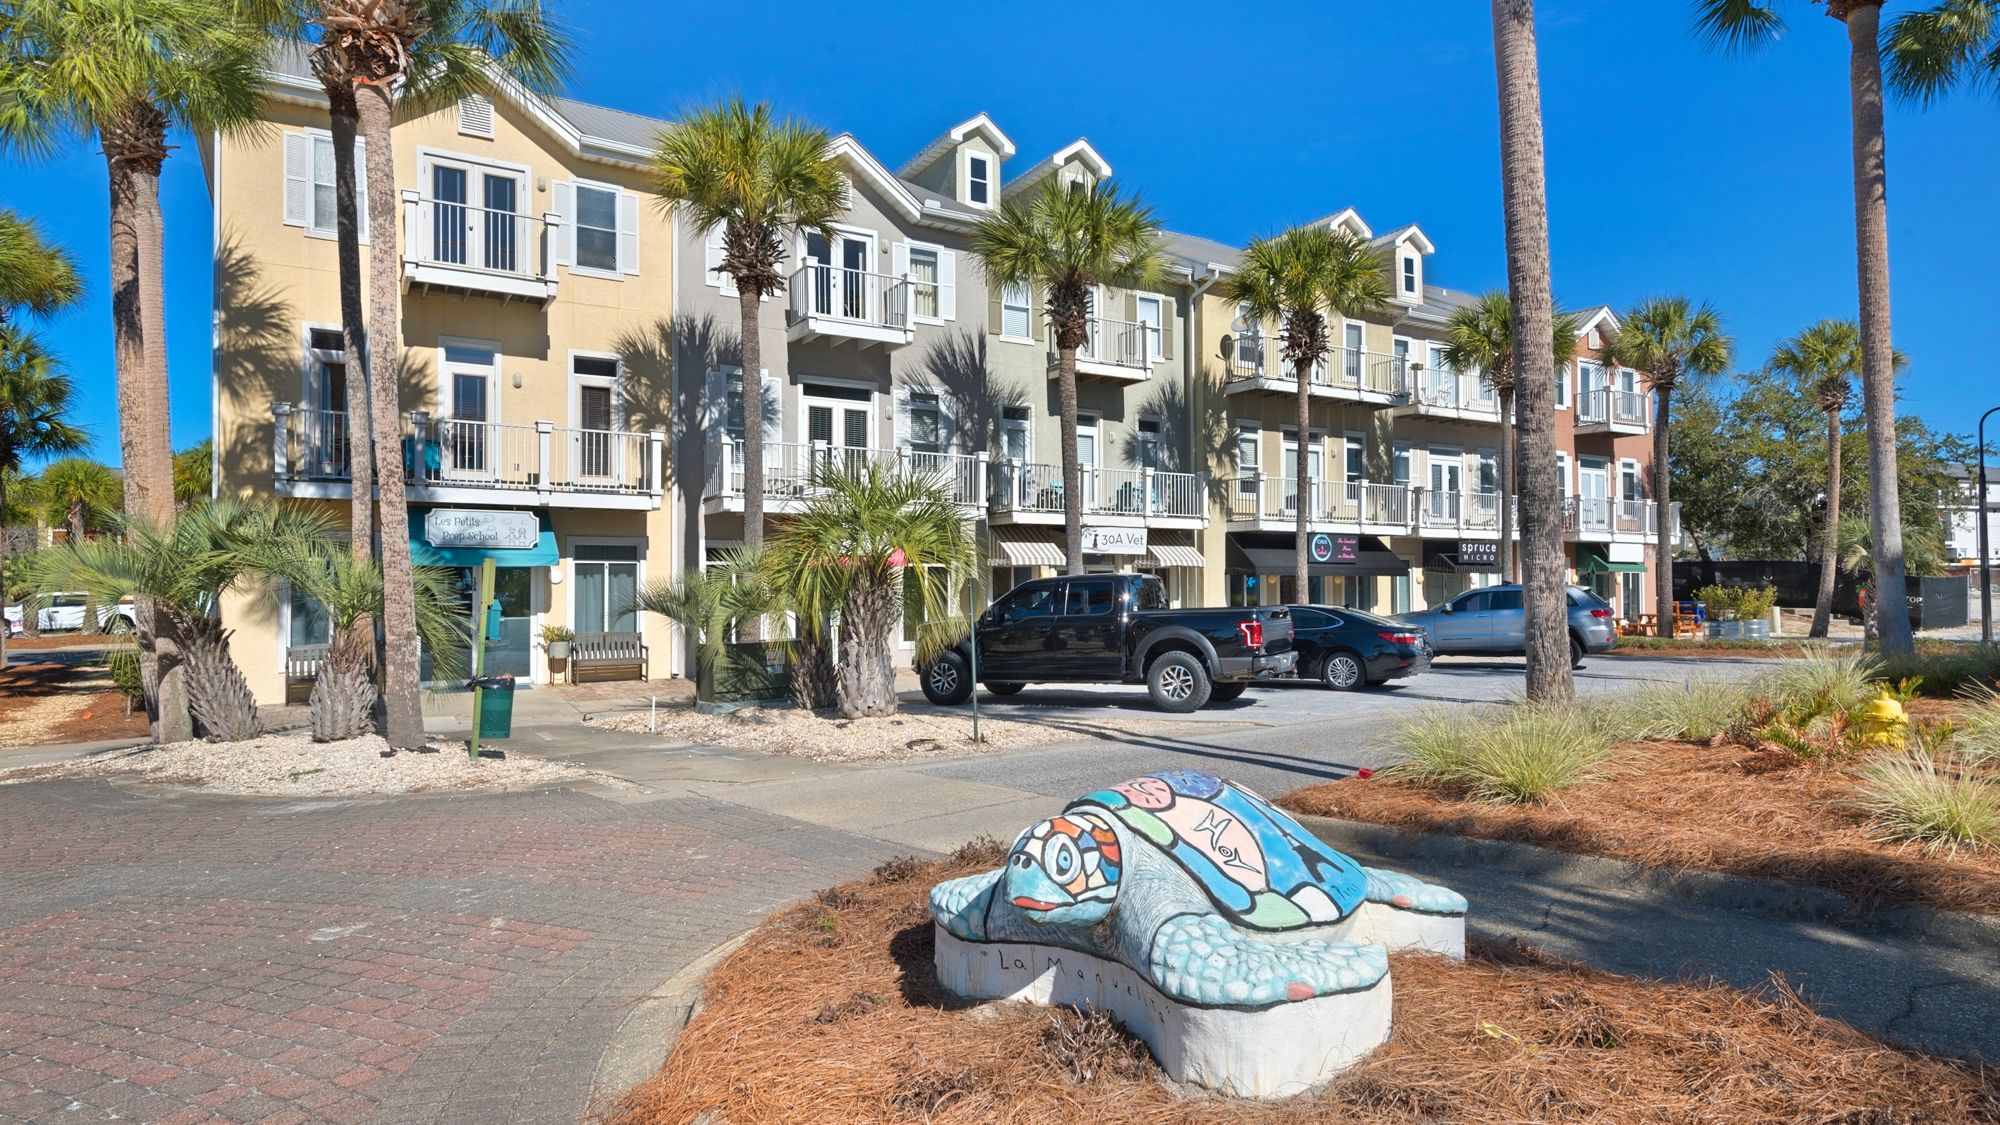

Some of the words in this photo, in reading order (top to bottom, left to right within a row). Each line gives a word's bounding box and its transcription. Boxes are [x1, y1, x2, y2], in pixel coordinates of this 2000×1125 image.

[434, 516, 451, 526] Les
[454, 517, 480, 527] Petits
[442, 531, 465, 543] Prep
[467, 532, 498, 543] School
[1101, 533, 1124, 546] 30A
[1126, 533, 1144, 546] Vet
[1462, 543, 1497, 554] spruce
